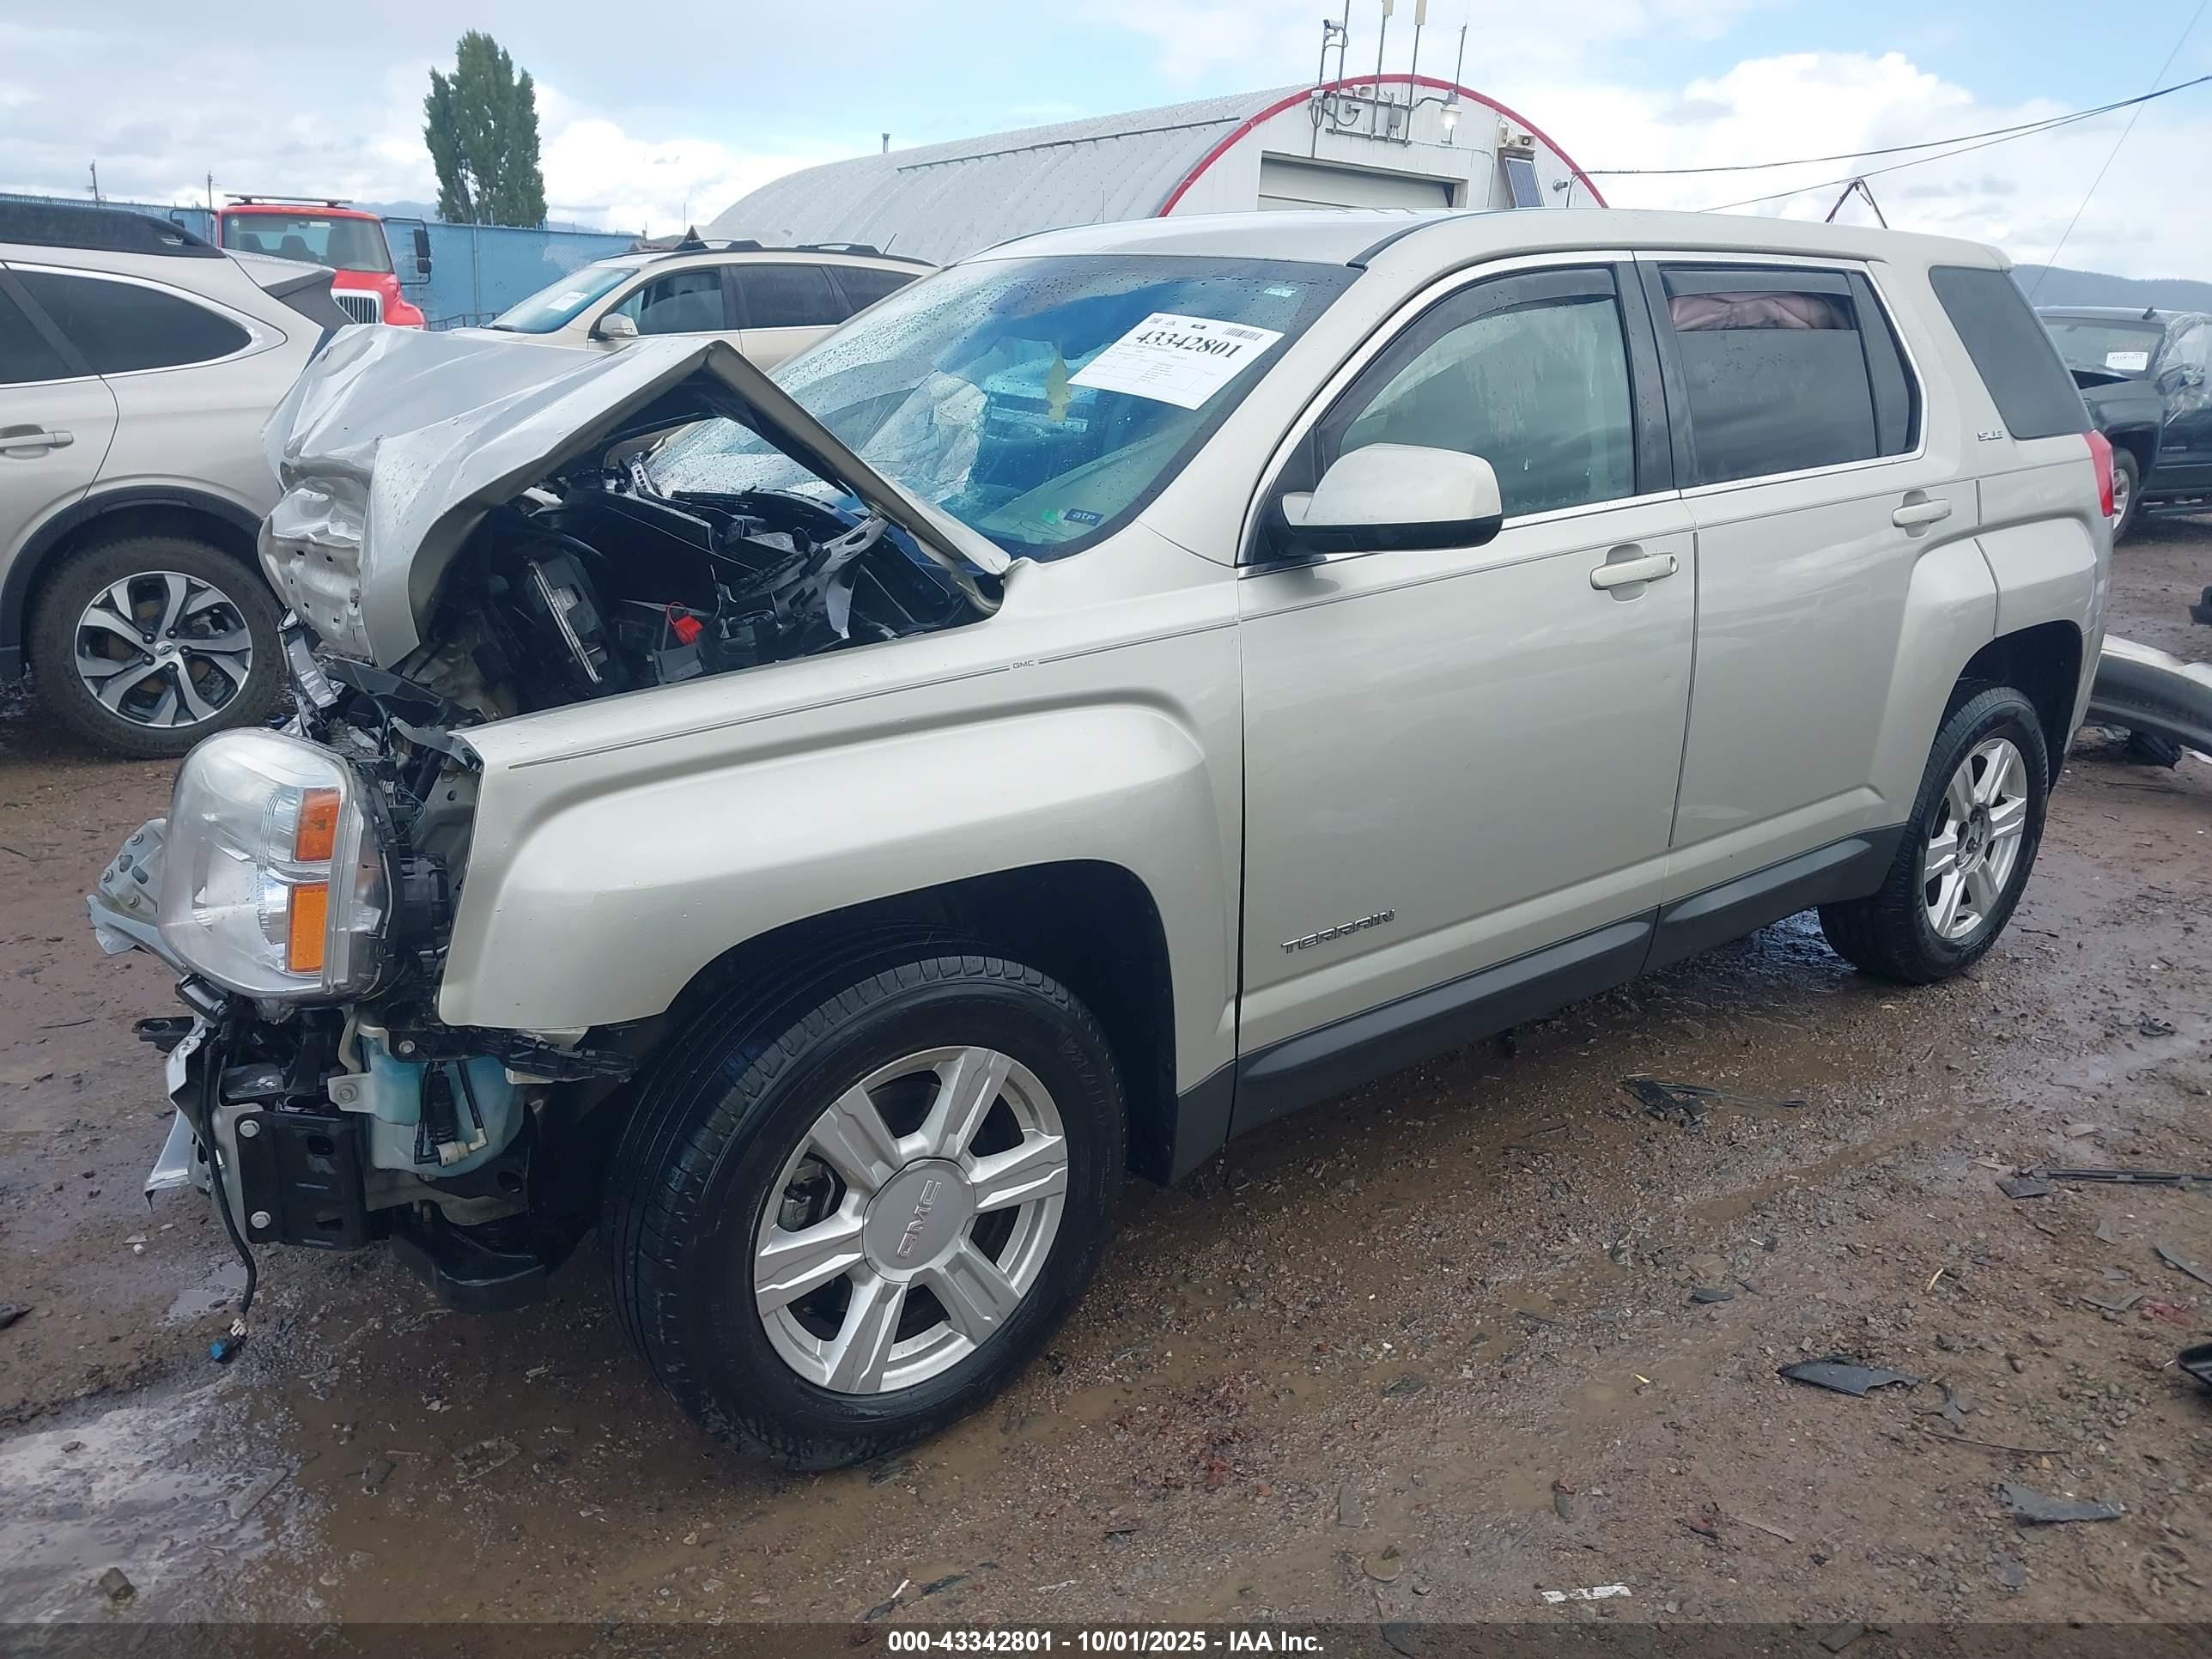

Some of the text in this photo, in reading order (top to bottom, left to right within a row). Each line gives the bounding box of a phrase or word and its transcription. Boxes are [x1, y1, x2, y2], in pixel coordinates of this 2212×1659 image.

[1136, 330, 1243, 359] 43342801
[1978, 429, 2003, 441] SLE
[1012, 659, 1035, 669] GMC
[1280, 908, 1396, 954] TERRAIN
[896, 1179, 942, 1259] GMC
